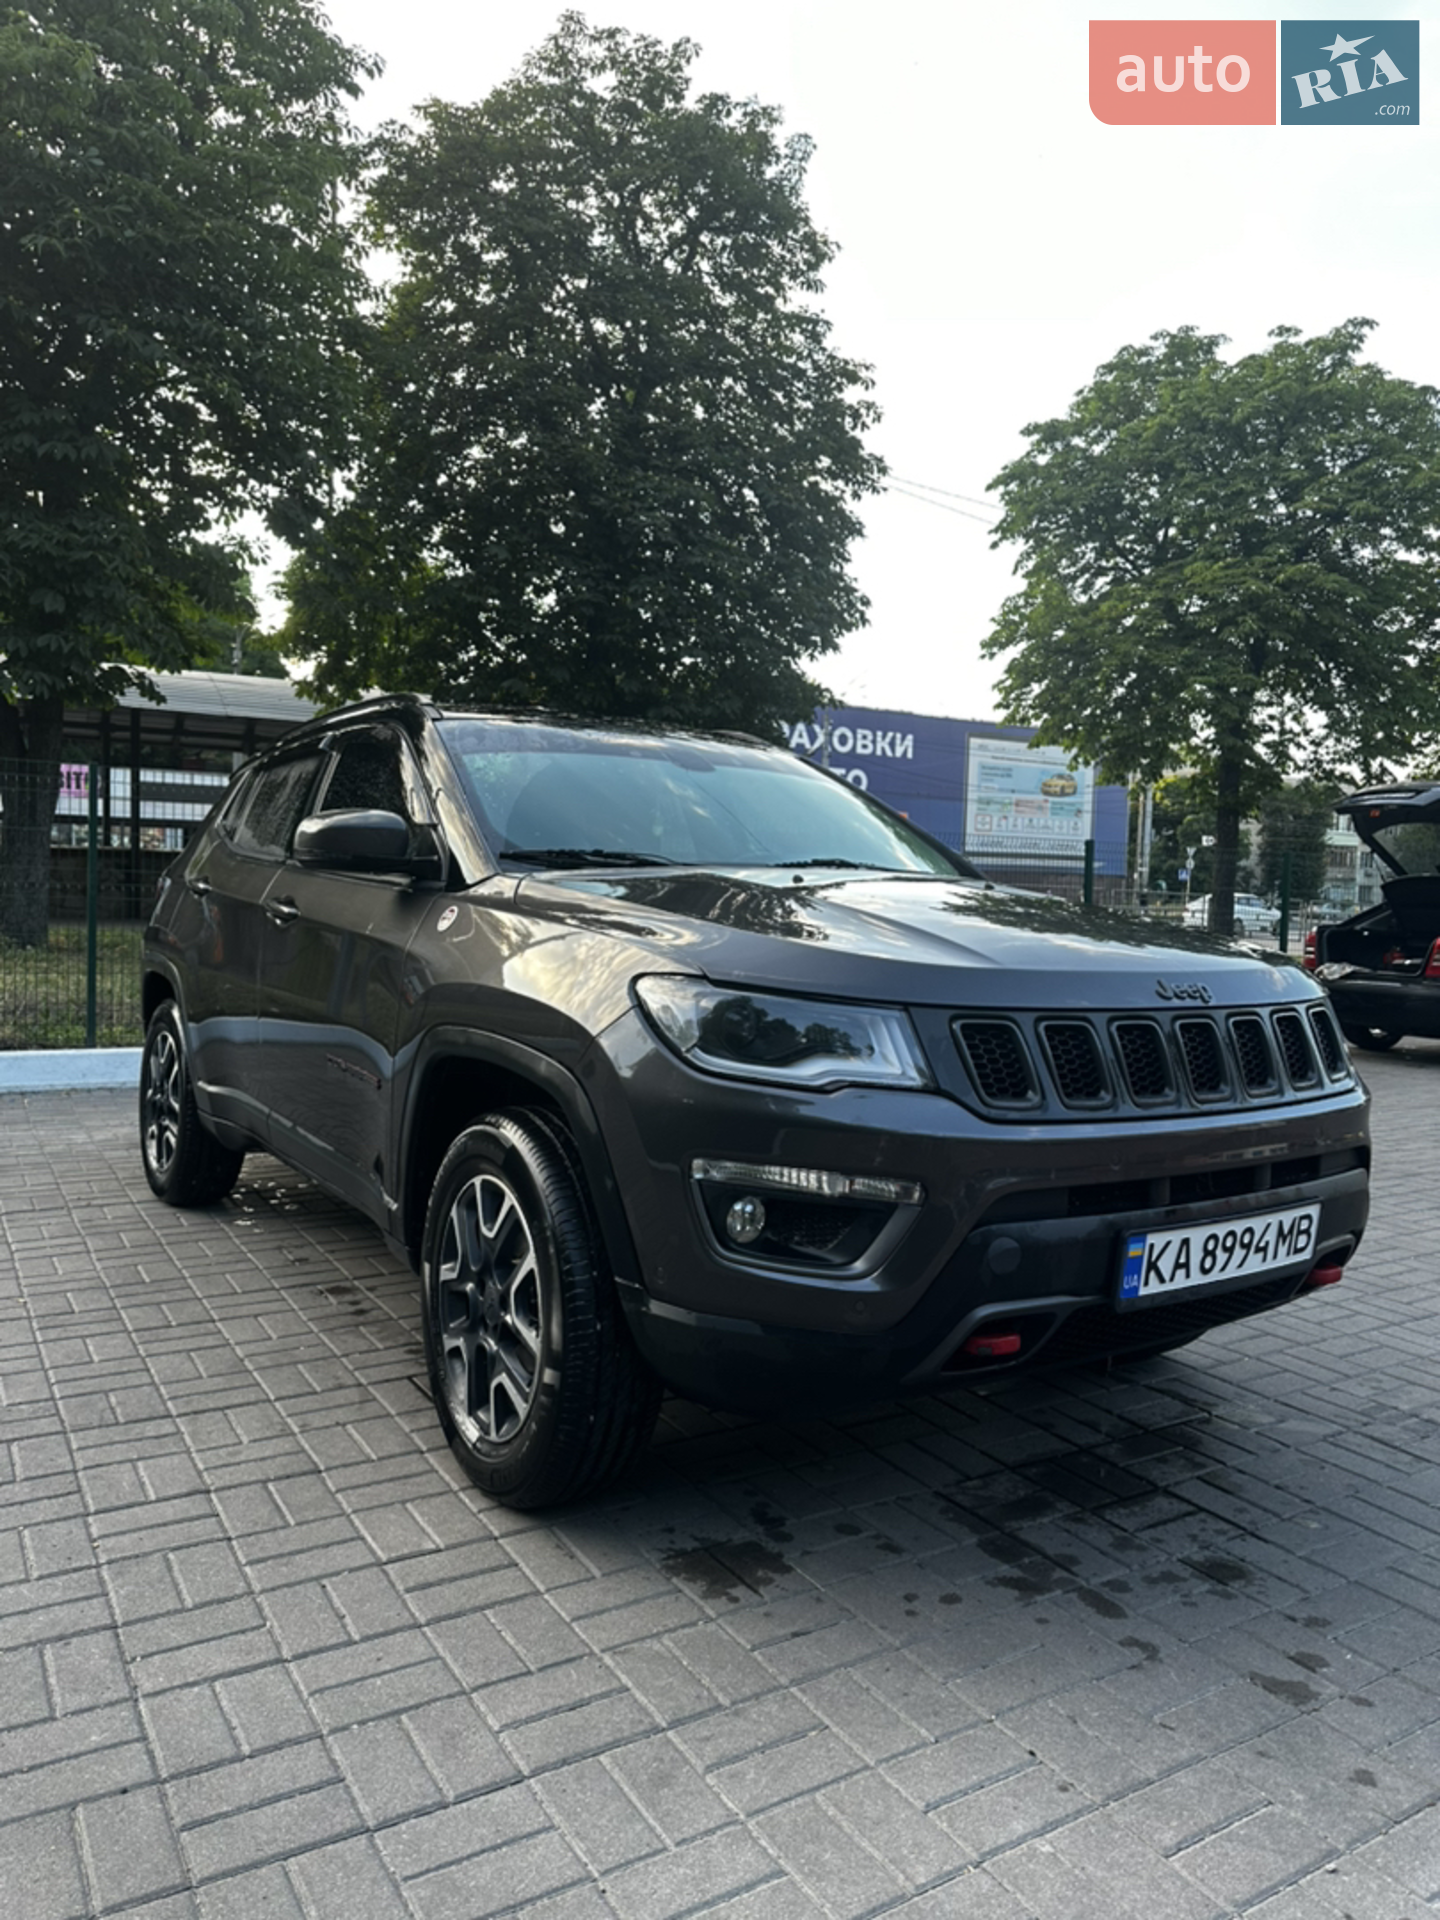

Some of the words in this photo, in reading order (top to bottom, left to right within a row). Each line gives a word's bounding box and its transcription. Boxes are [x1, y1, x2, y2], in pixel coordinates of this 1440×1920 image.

[1155, 979, 1213, 1004] Jeep
[1143, 1237, 1191, 1287] KA
[1199, 1221, 1272, 1276] 8994
[1272, 1213, 1314, 1261] MB
[1123, 1275, 1139, 1289] UA
